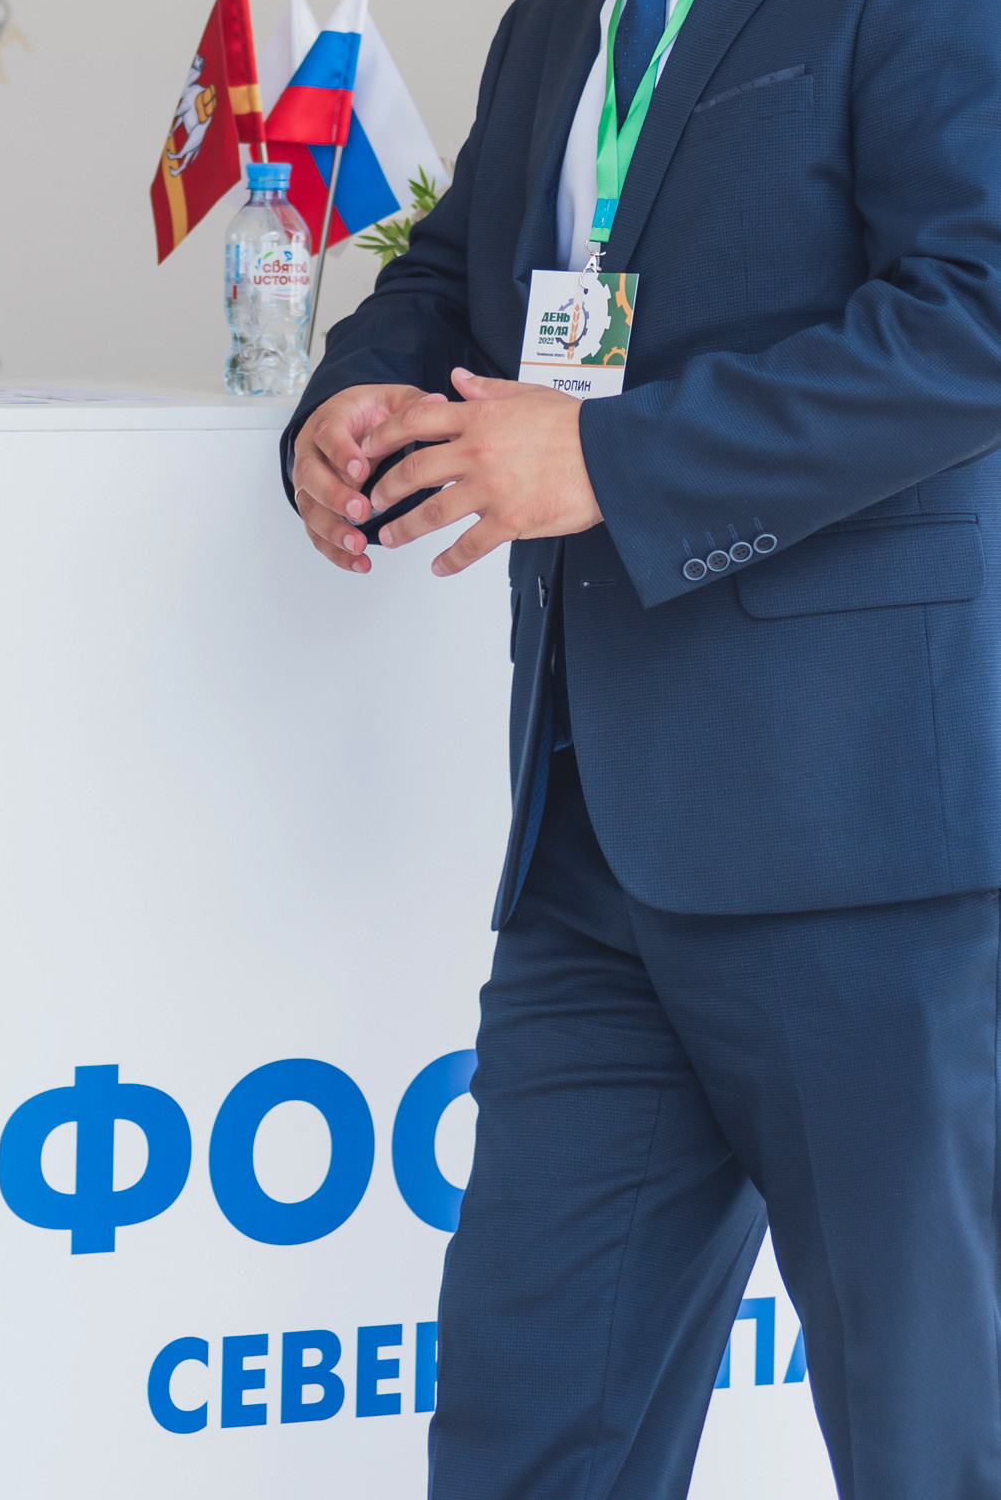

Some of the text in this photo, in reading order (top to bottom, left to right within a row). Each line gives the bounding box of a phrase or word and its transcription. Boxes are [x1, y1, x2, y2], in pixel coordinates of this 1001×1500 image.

[541, 311, 571, 323] ДЕНЬ
[539, 325, 569, 336] ПОЛЯ
[538, 336, 555, 345] 2022
[553, 379, 592, 392] ТРОПИН
